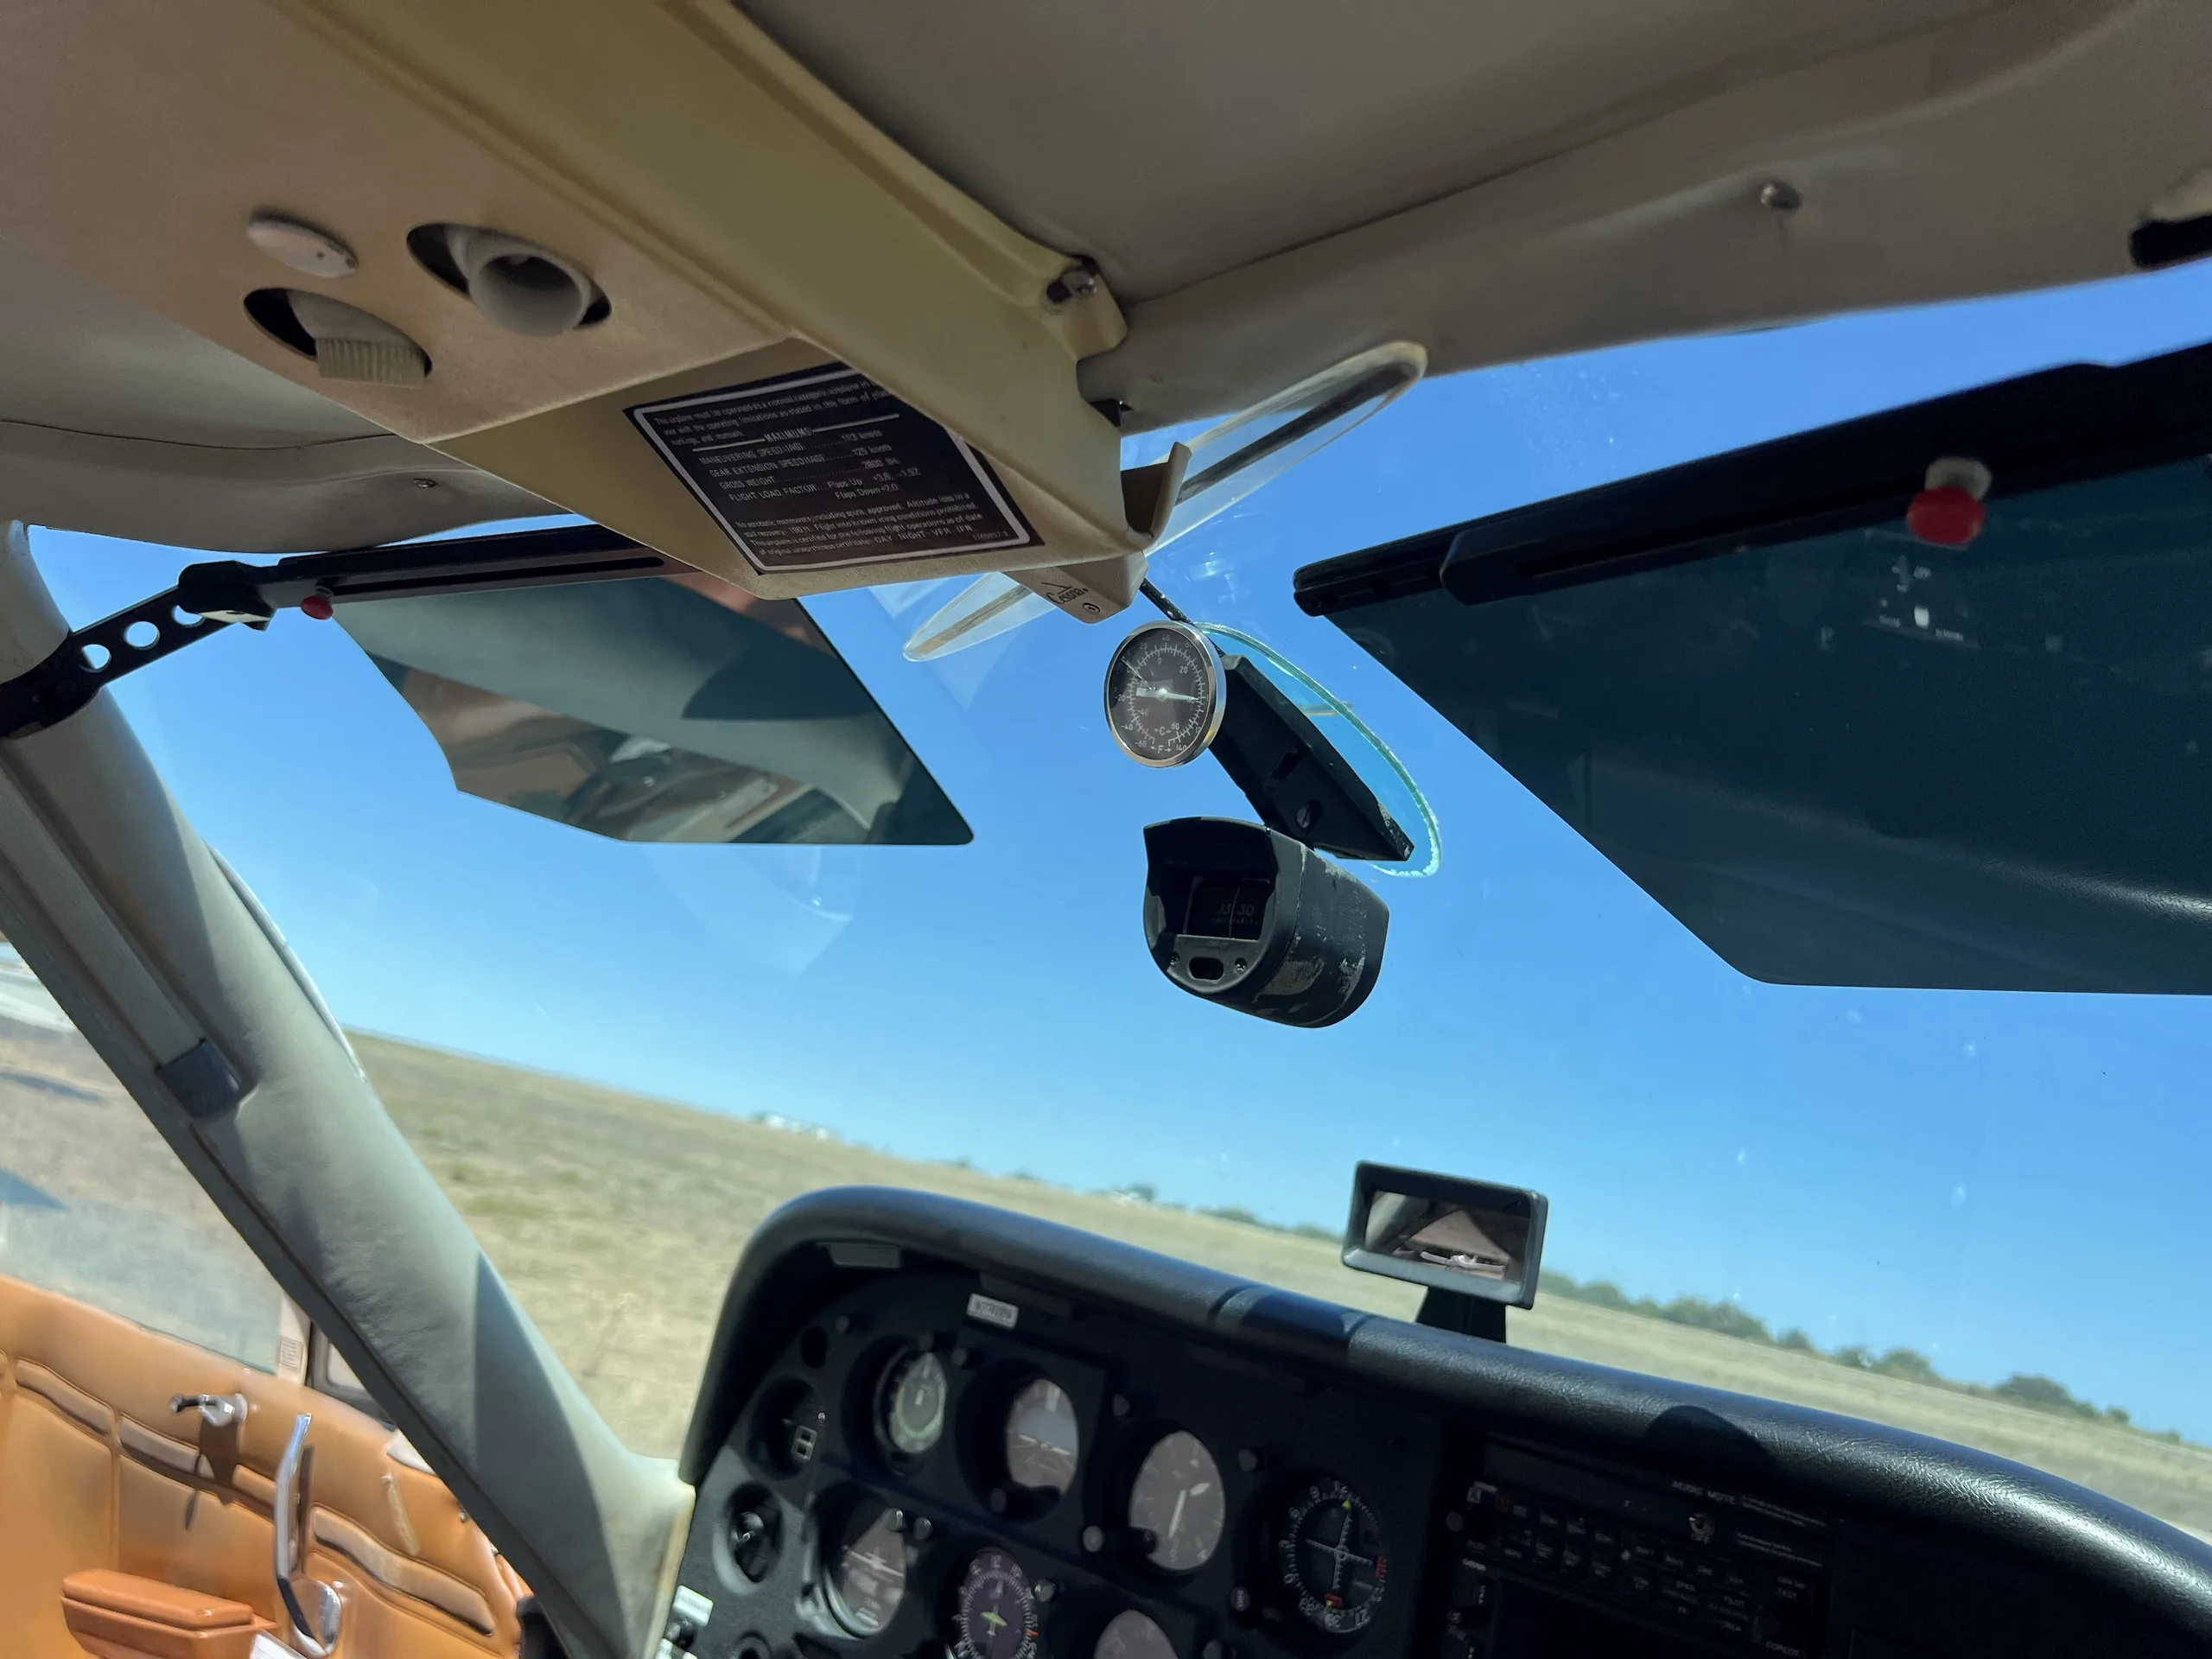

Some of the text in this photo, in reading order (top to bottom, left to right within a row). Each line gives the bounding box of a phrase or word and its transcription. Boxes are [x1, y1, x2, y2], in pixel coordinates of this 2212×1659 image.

[653, 416, 669, 425] This
[665, 412, 695, 424] airplane
[690, 409, 709, 418] must
[718, 402, 753, 415] operated
[765, 394, 793, 404] normal
[791, 388, 829, 401] category
[826, 382, 861, 395] airplane
[703, 416, 740, 429] operating
[737, 410, 778, 422] limitations
[785, 404, 811, 414] stated
[821, 398, 839, 408] the
[836, 395, 859, 404] form
[763, 427, 813, 441] MAXIMUMS
[698, 449, 757, 465] MANEUVERING
[755, 445, 785, 455] SPEED
[857, 429, 884, 439] knots
[709, 468, 732, 477] GEAR
[731, 461, 778, 474] EXTENSION
[777, 456, 804, 467] SPEED
[850, 447, 868, 455] 125
[867, 442, 893, 453] knots
[718, 480, 746, 489] GROSS
[743, 475, 777, 486] WEIGHT
[860, 459, 884, 468] 2800
[728, 491, 759, 501] FLIGHT
[756, 487, 782, 497] LOAD
[781, 483, 817, 493] FACTOR
[824, 478, 850, 489] Flaps
[833, 484, 900, 500] Flaps Down +2.0
[811, 509, 846, 520] including
[843, 506, 867, 516] spins,
[904, 497, 938, 506] Altitude
[812, 521, 836, 531] Flight
[849, 516, 877, 524] known
[876, 514, 897, 523] icing
[894, 509, 936, 518] conditions
[763, 537, 792, 546] airplane
[795, 532, 826, 541] certified
[849, 525, 886, 536] following
[883, 523, 906, 531] flight
[904, 518, 947, 529] operations
[766, 546, 792, 556] original
[789, 542, 835, 551] airworthiness
[897, 531, 926, 539] NIGHT
[1046, 588, 1084, 604] Cessna
[1179, 665, 1188, 674] 20
[1159, 726, 1166, 736] C
[1157, 745, 1164, 753] F
